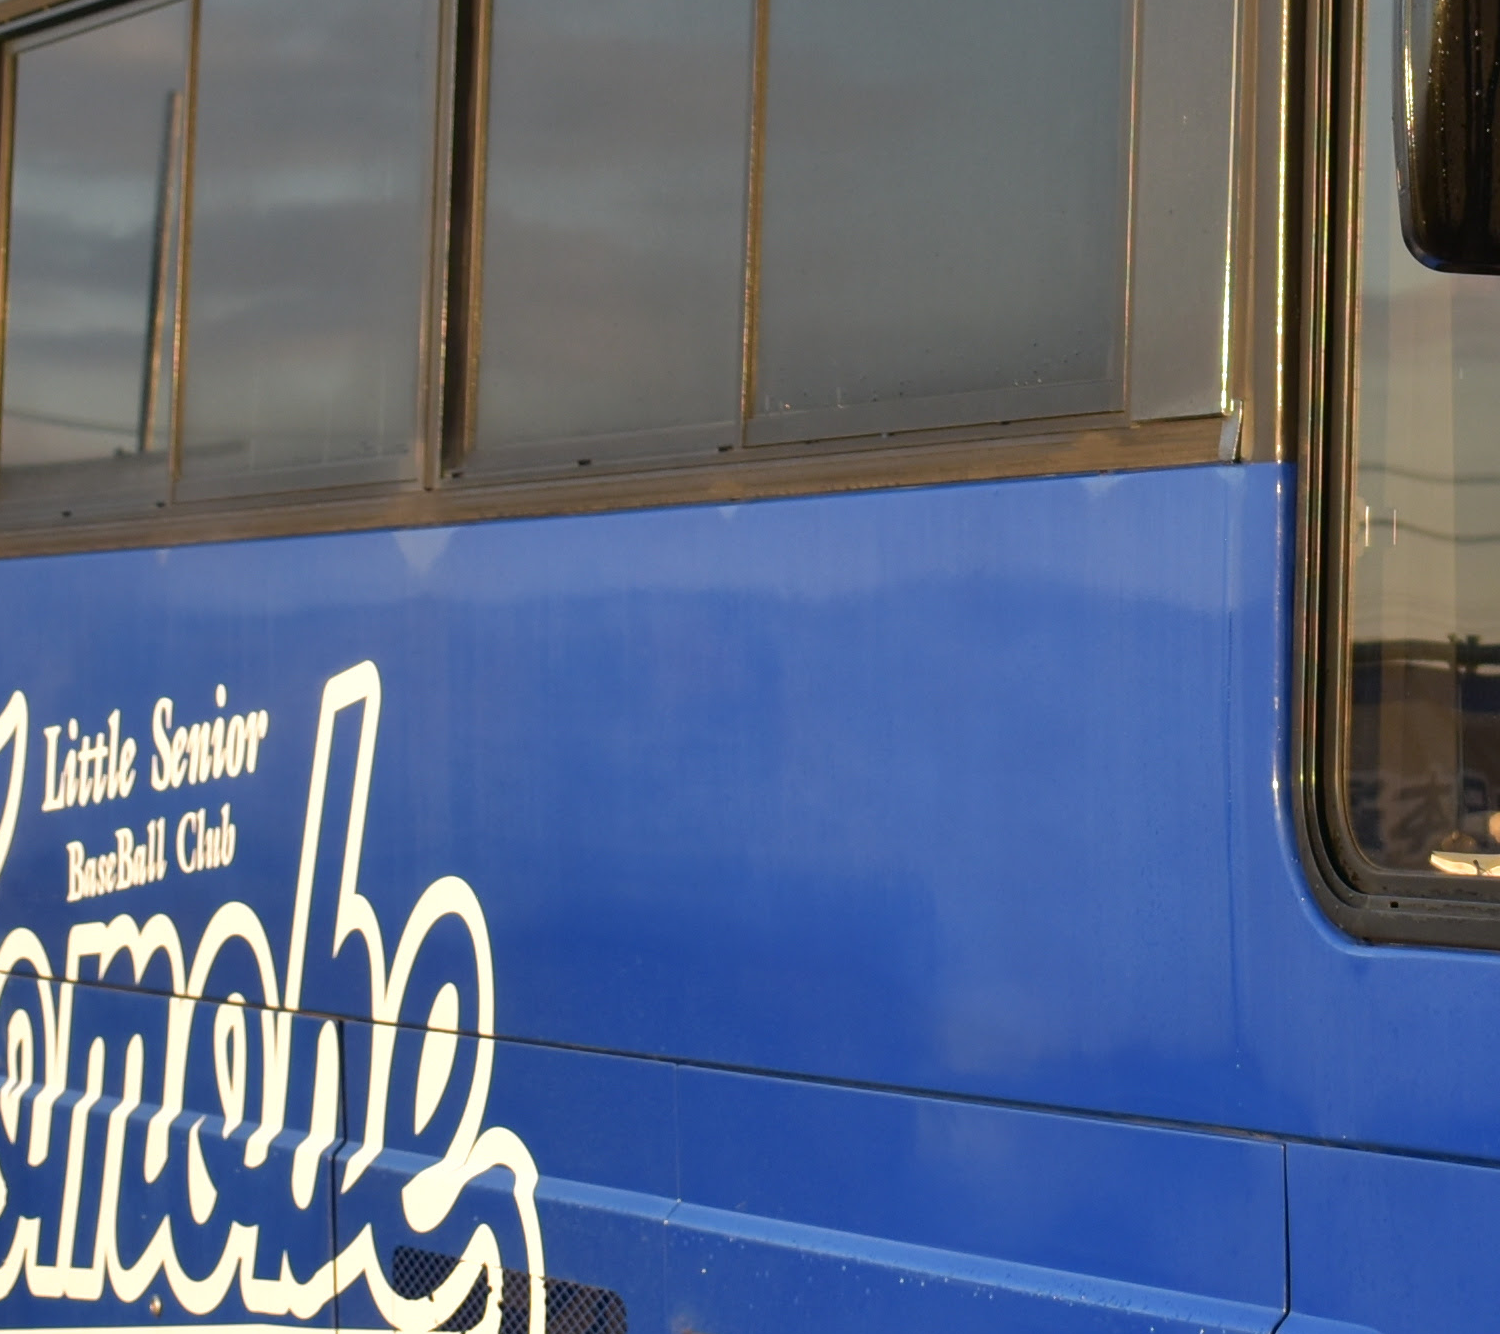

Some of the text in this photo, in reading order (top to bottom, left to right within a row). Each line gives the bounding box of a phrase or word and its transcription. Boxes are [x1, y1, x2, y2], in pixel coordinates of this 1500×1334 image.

[41, 683, 269, 813] Little Senior
[65, 803, 237, 903] BaseBall Club
